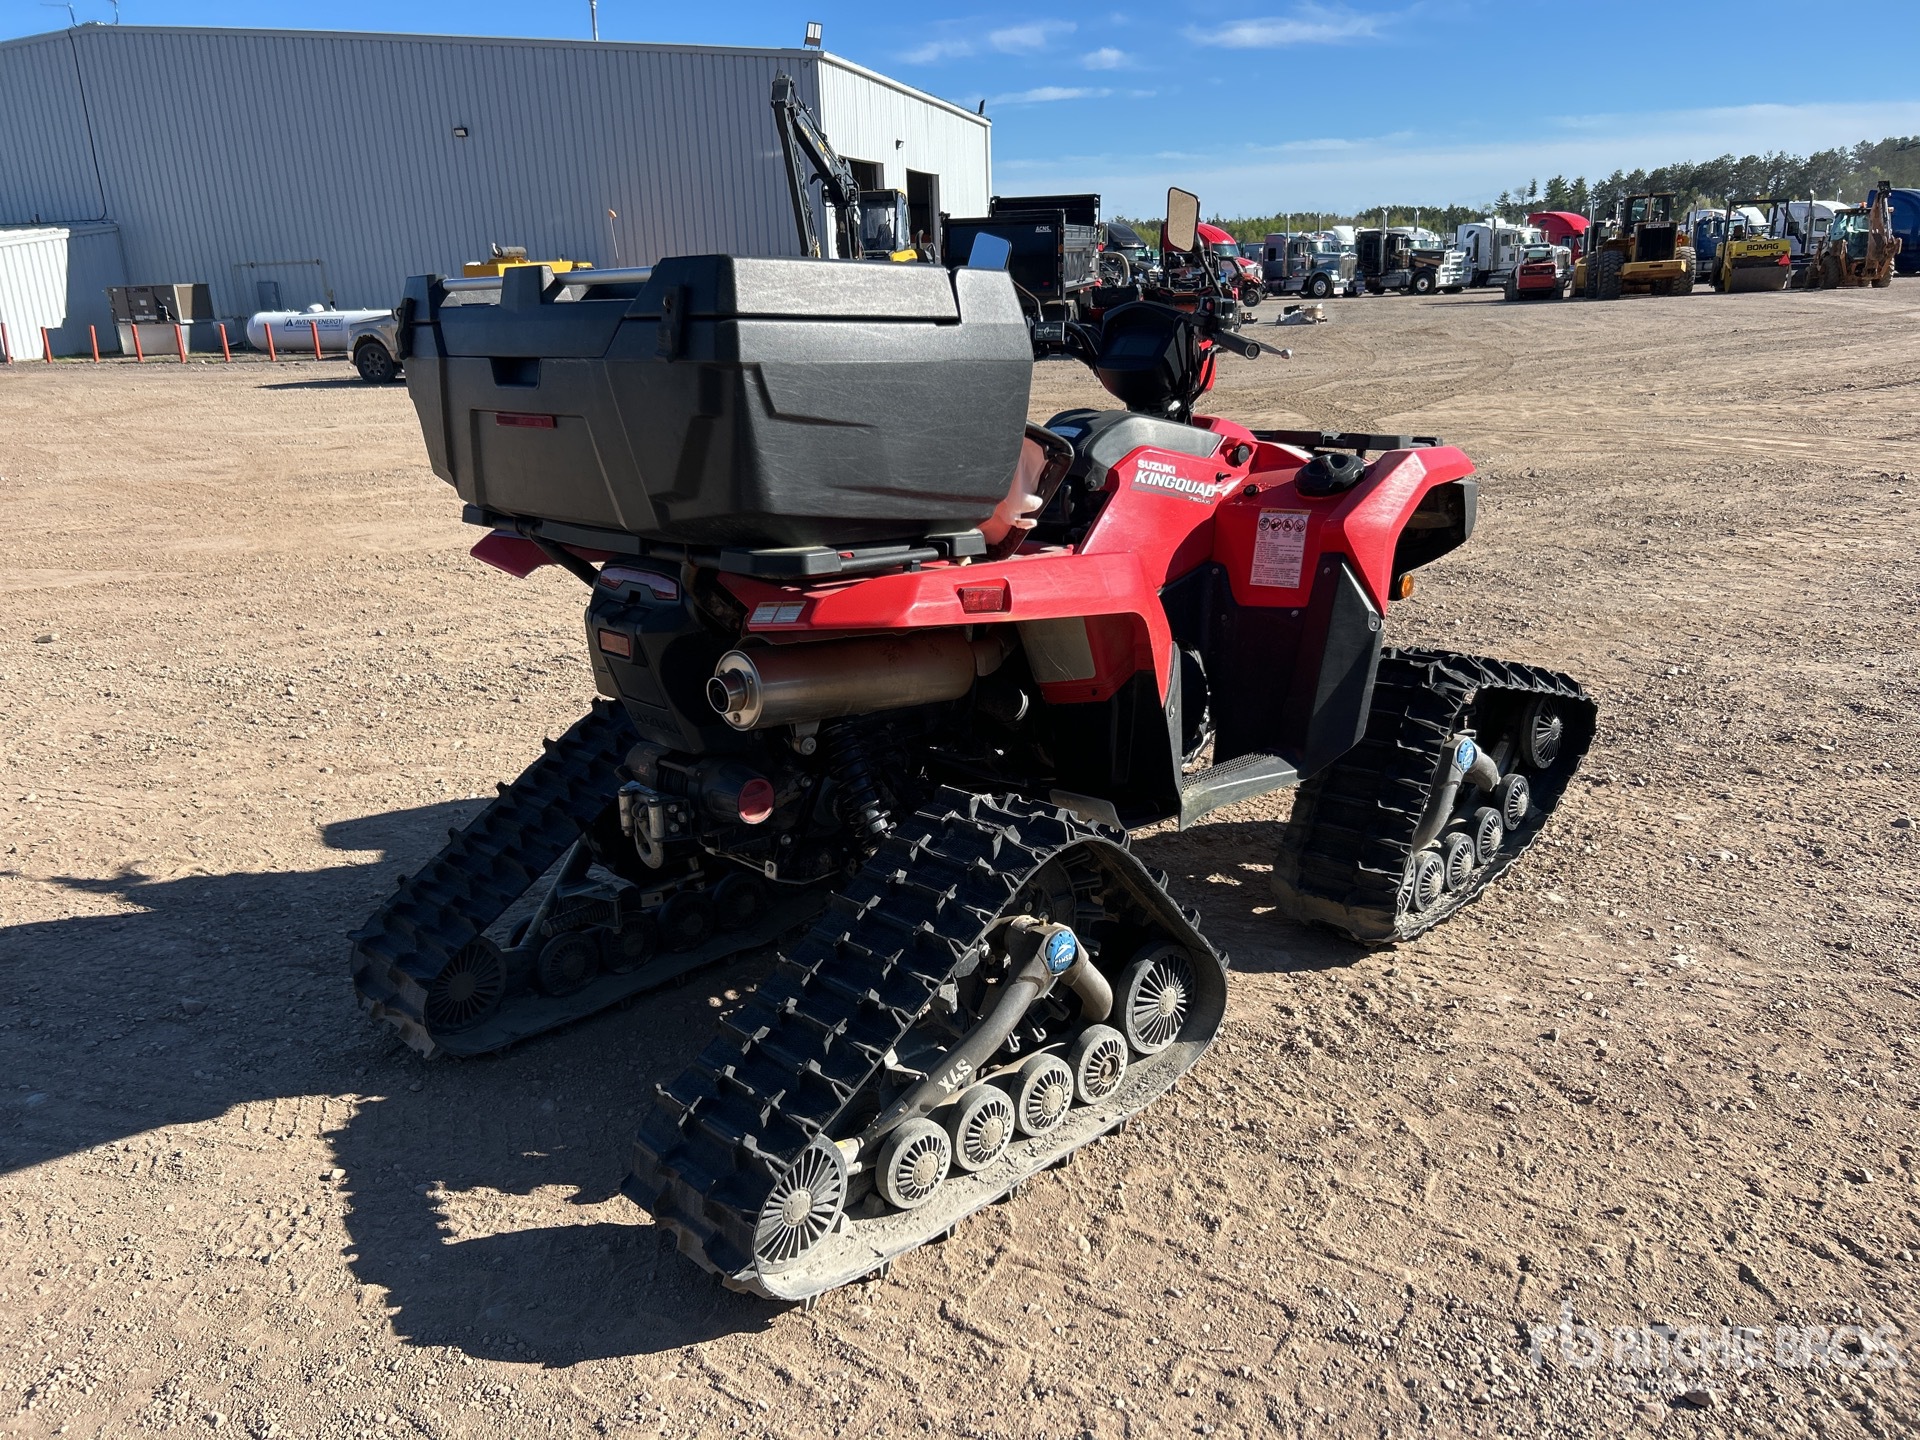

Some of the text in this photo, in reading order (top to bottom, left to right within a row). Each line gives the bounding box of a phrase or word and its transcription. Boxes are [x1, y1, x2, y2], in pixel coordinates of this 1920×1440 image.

[1137, 459, 1176, 475] SUZUKI
[1134, 470, 1216, 498] KINGQUAD
[630, 710, 683, 736] SUZUKI
[937, 1058, 973, 1094] X4S
